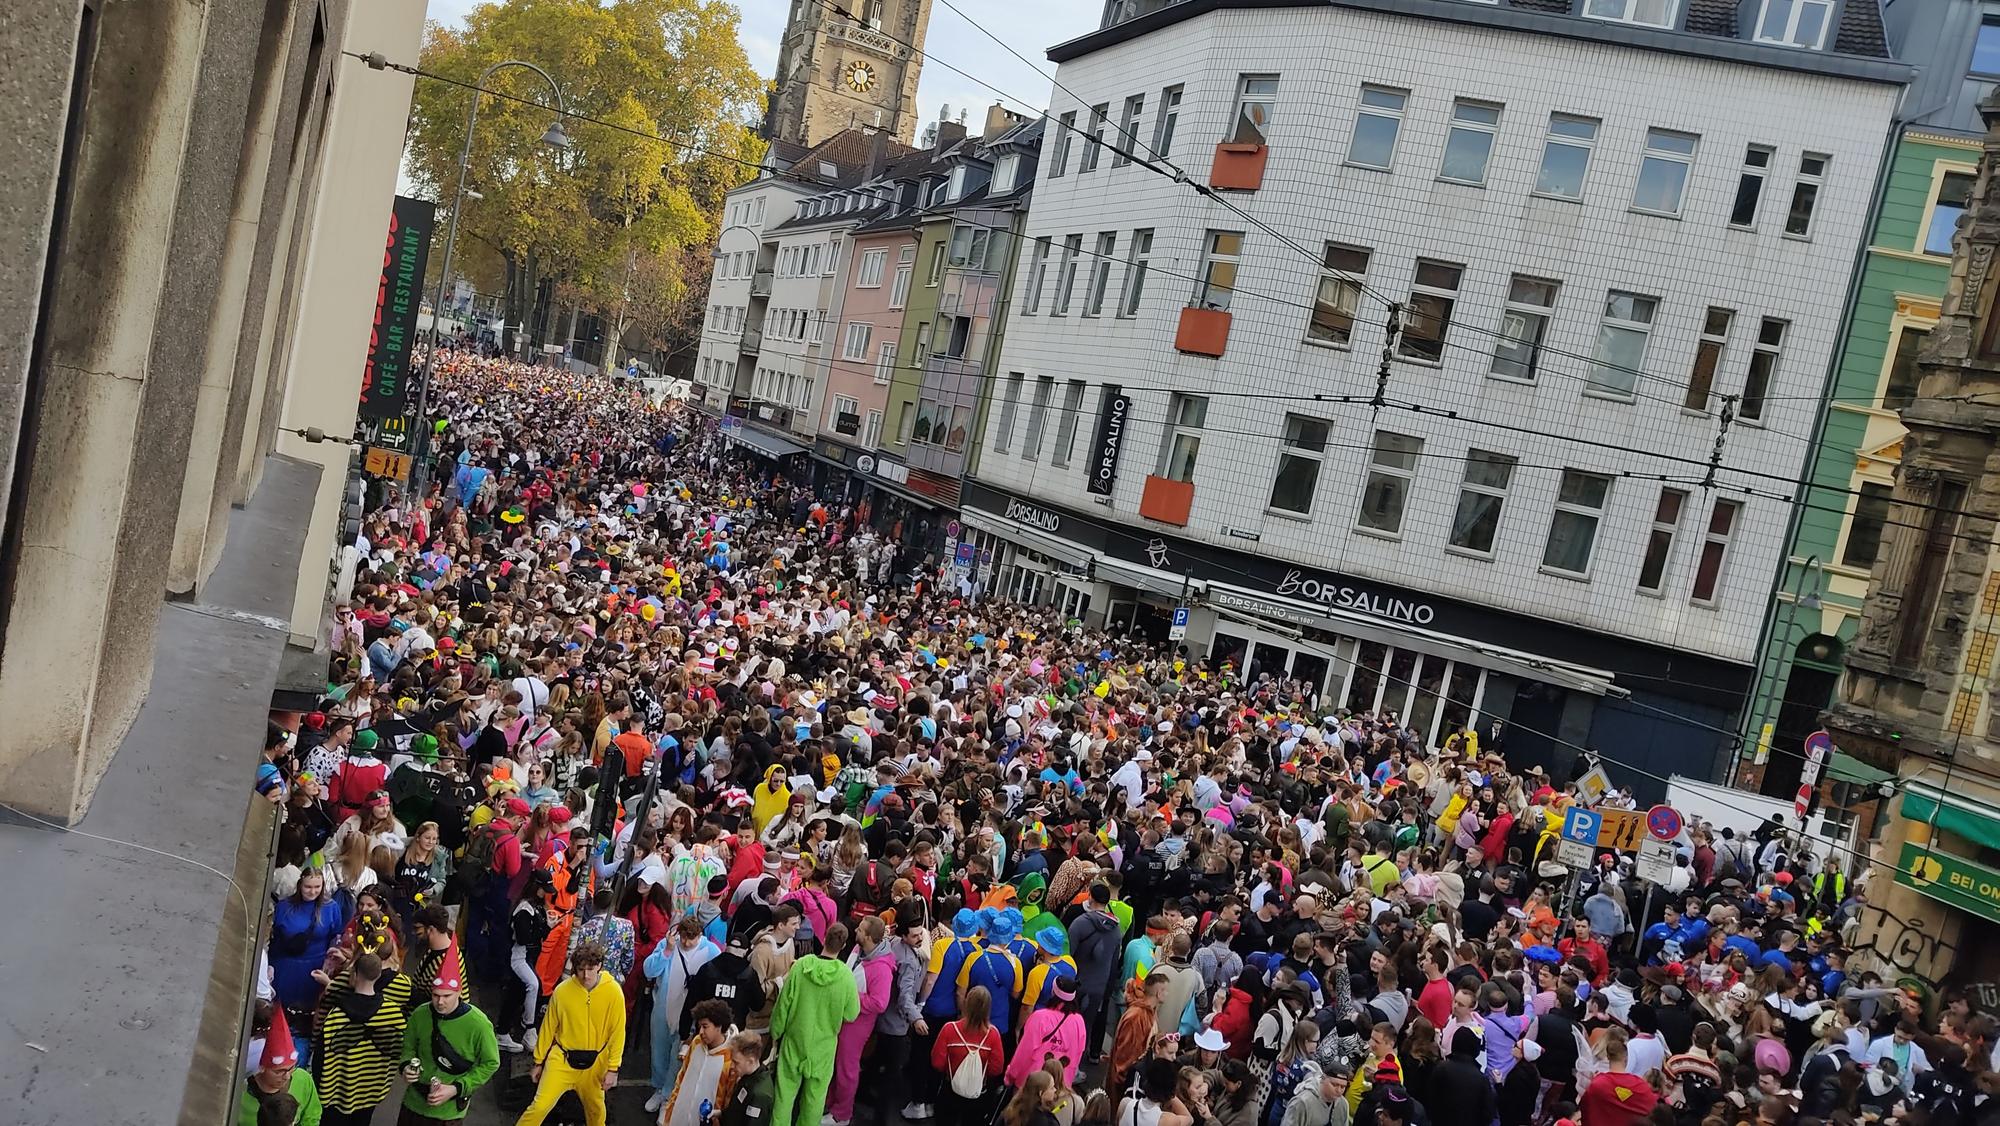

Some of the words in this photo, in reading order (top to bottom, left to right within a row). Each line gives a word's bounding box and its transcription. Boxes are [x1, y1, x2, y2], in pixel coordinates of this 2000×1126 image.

[393, 226, 420, 314] RESTAURANT
[387, 325, 405, 352] BAR
[379, 362, 398, 396] CAFÉ
[1093, 399, 1125, 493] BORSALINO
[1005, 496, 1060, 532] BORSALINO
[1219, 594, 1287, 618] BORSALINO
[1276, 567, 1435, 625] BORSALINO
[1571, 811, 1594, 837] P
[1950, 871, 1975, 890] BEI
[715, 983, 736, 999] FBI
